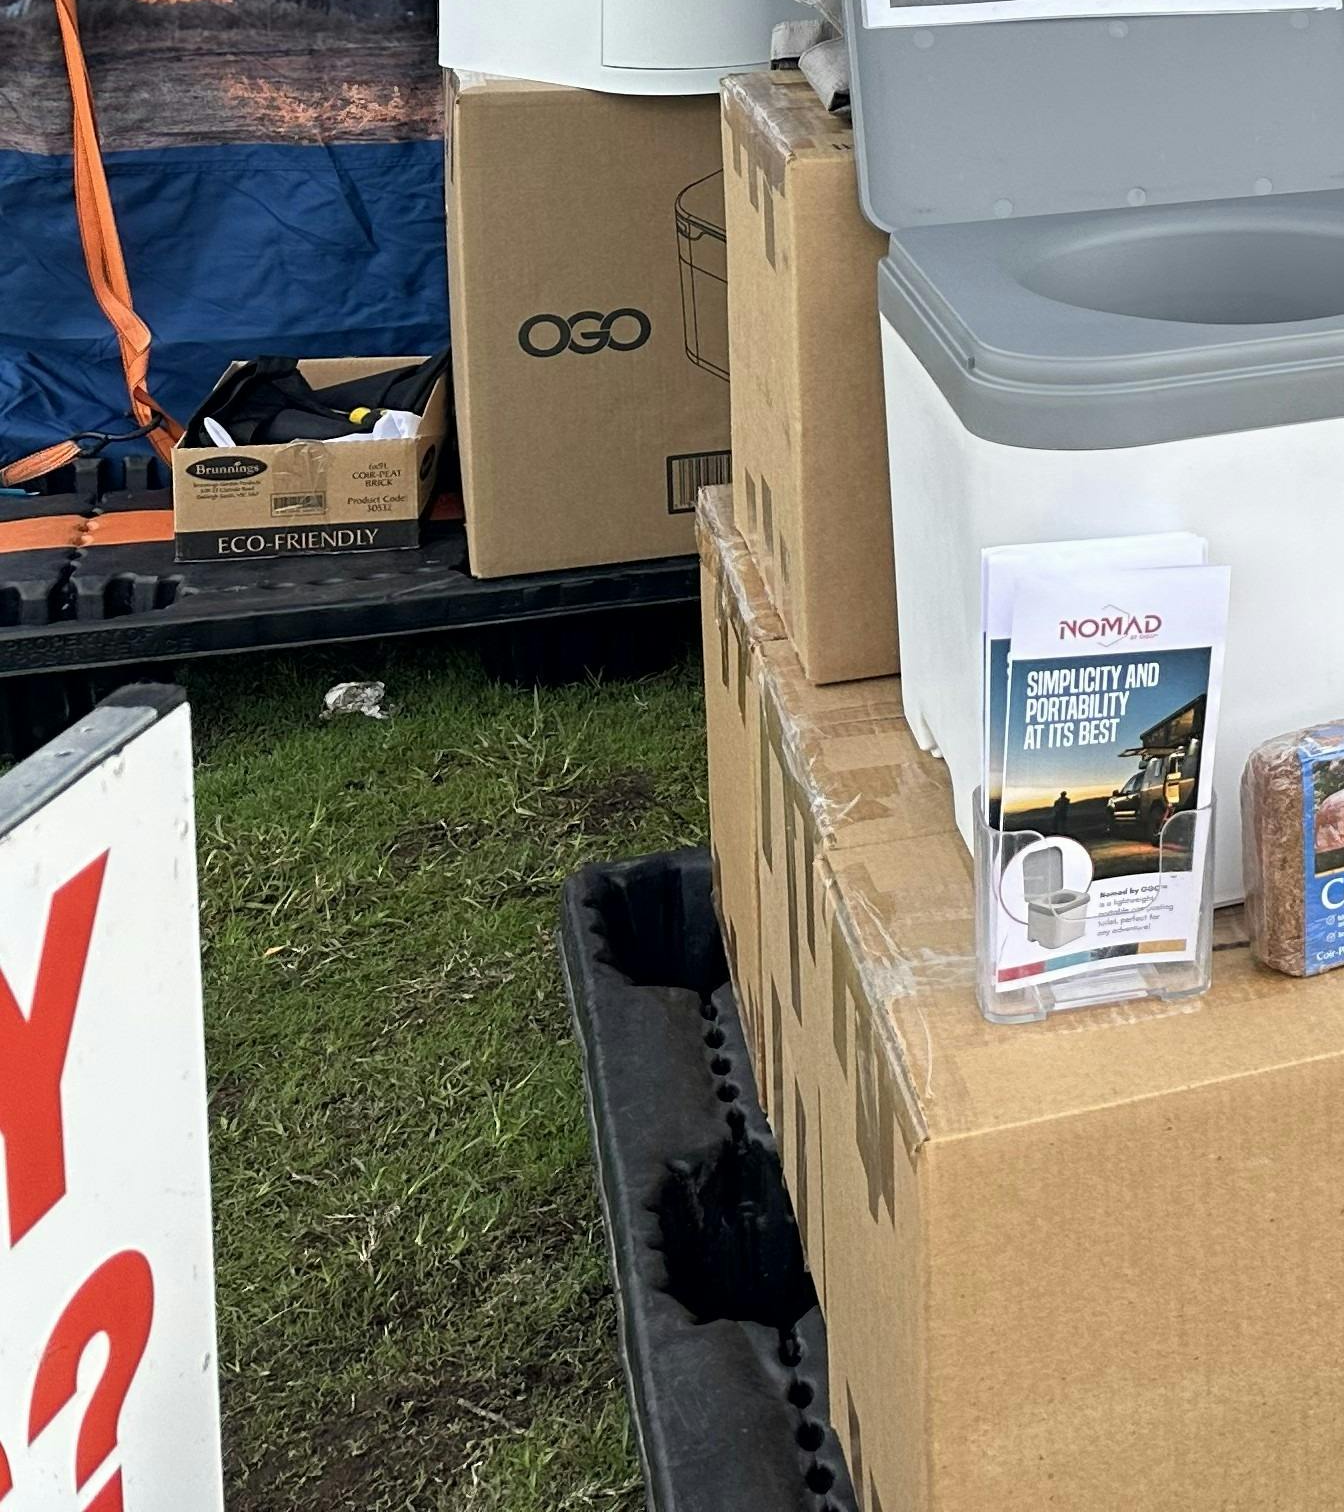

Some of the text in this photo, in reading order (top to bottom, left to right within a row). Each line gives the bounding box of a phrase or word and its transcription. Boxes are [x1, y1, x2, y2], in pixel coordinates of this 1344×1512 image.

[518, 308, 651, 357] OGO
[1060, 615, 1161, 639] NOMAD
[1027, 663, 1159, 696] SIMPLICITY AND
[1026, 691, 1129, 723] PORTABILITY
[1024, 718, 1120, 750] AT ITS BEST
